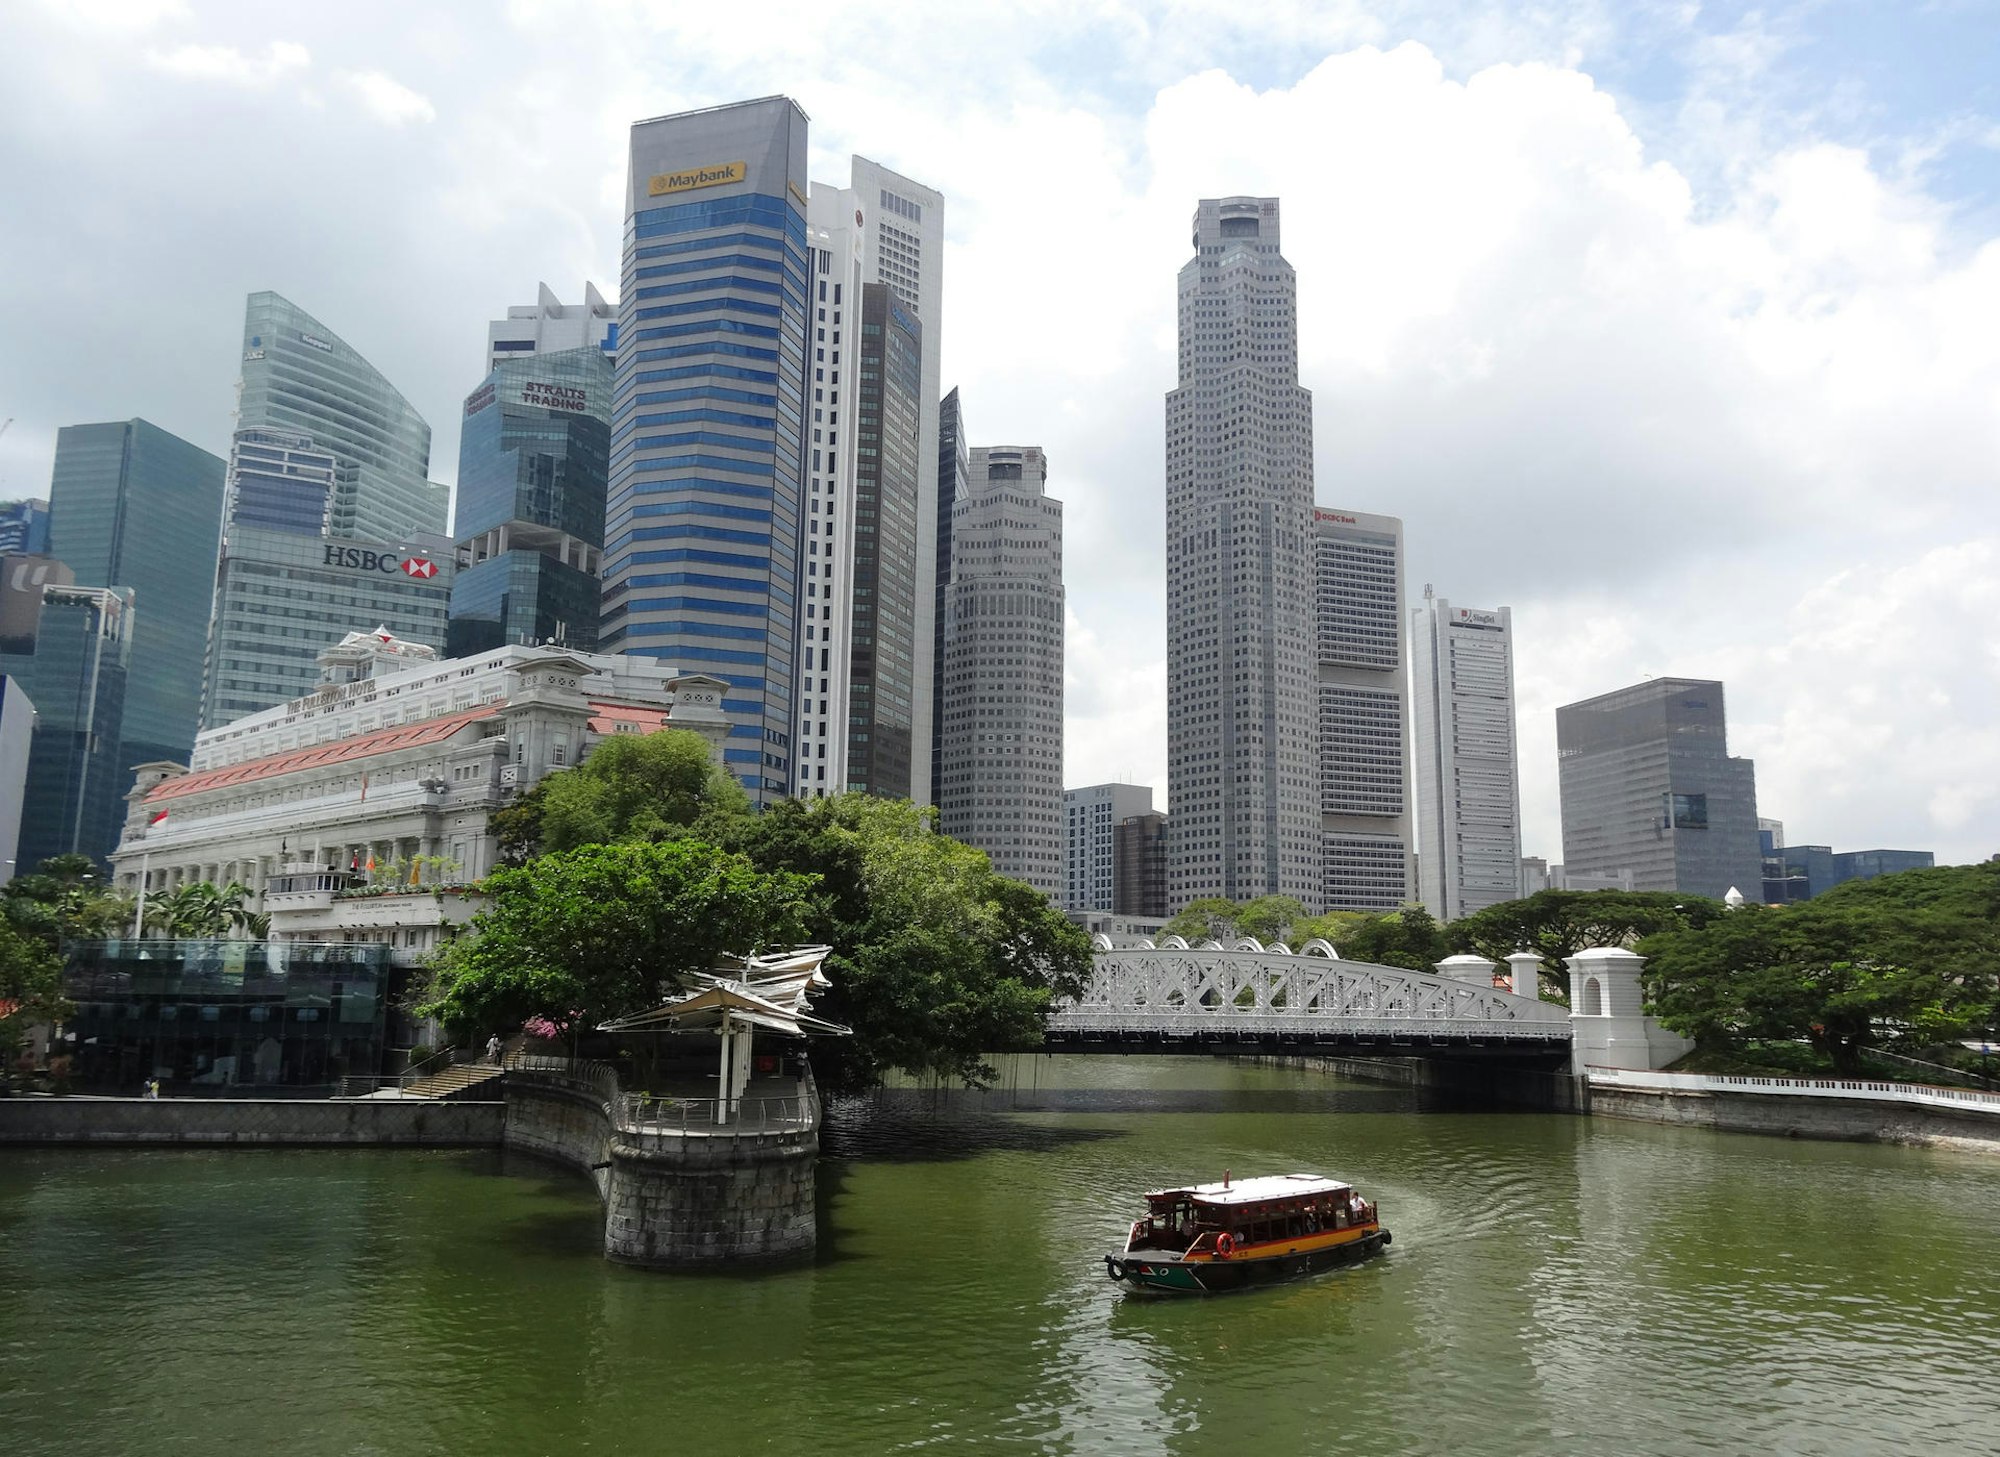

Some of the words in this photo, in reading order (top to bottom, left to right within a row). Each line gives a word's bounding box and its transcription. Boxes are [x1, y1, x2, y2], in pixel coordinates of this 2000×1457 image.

[668, 166, 735, 188] Maybank
[302, 334, 332, 351] Keppel
[526, 381, 586, 400] STRAITS
[521, 392, 585, 411] TRADING
[322, 544, 398, 574] HSBC
[348, 679, 376, 699] HOTEL
